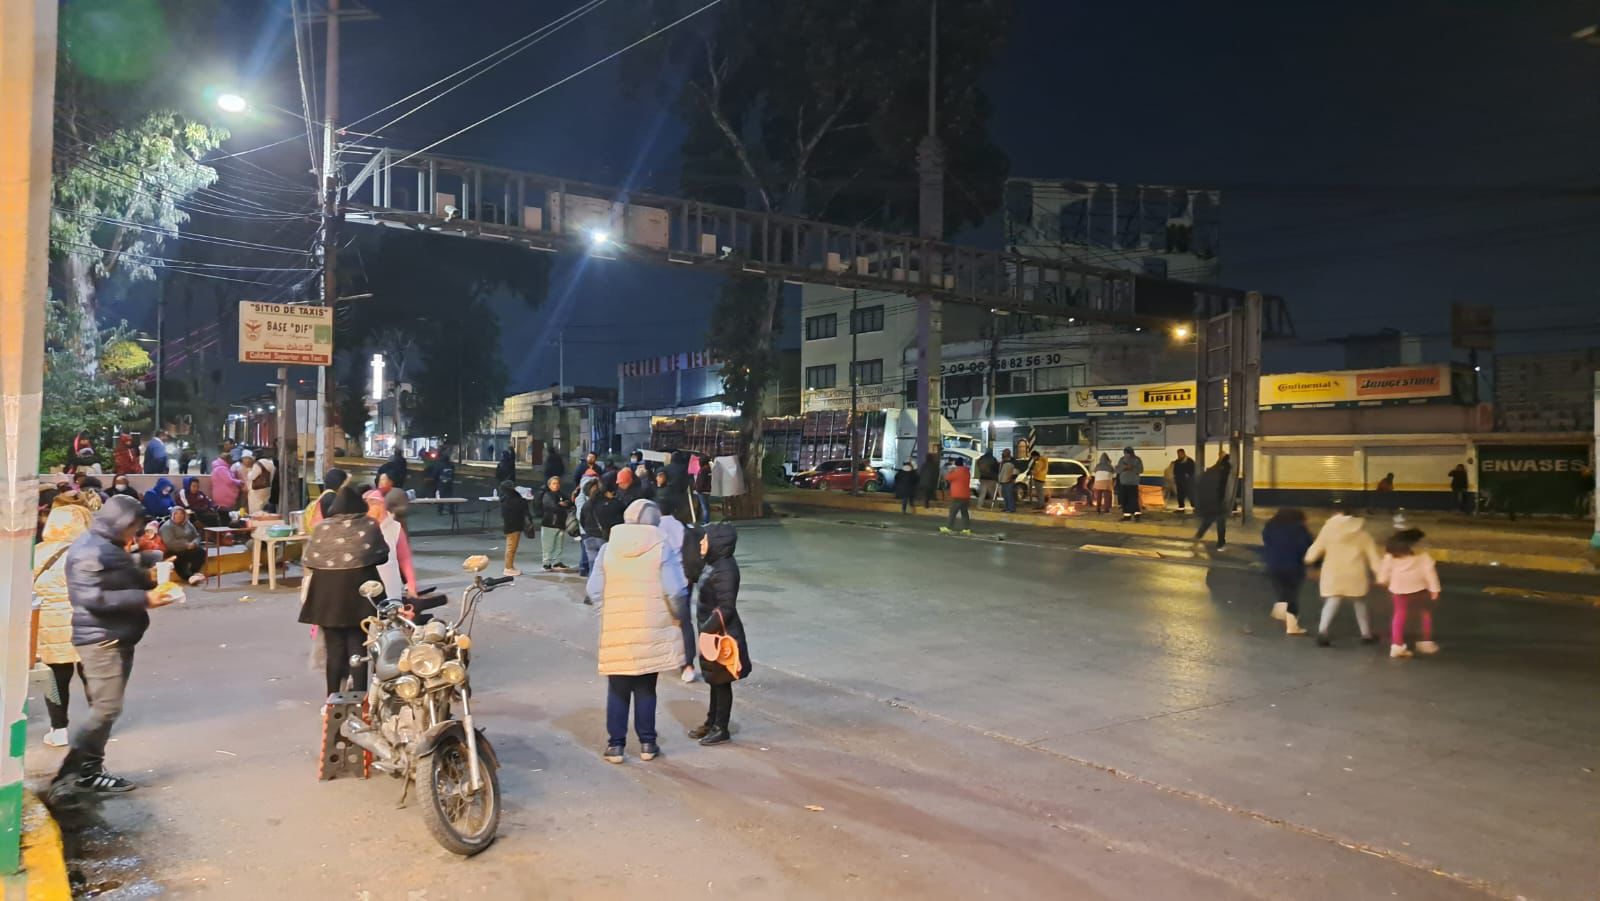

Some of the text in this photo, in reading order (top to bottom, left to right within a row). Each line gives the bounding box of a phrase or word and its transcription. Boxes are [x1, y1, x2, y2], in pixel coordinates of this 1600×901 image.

[250, 304, 328, 317] "SITIO DE TAXIS"
[266, 321, 313, 334] BASE "DIF"
[1278, 381, 1331, 392] Continental
[1360, 377, 1436, 389] BRIDGESTONE
[1144, 388, 1191, 402] PIRELLI
[1481, 459, 1586, 472] ENVASES
